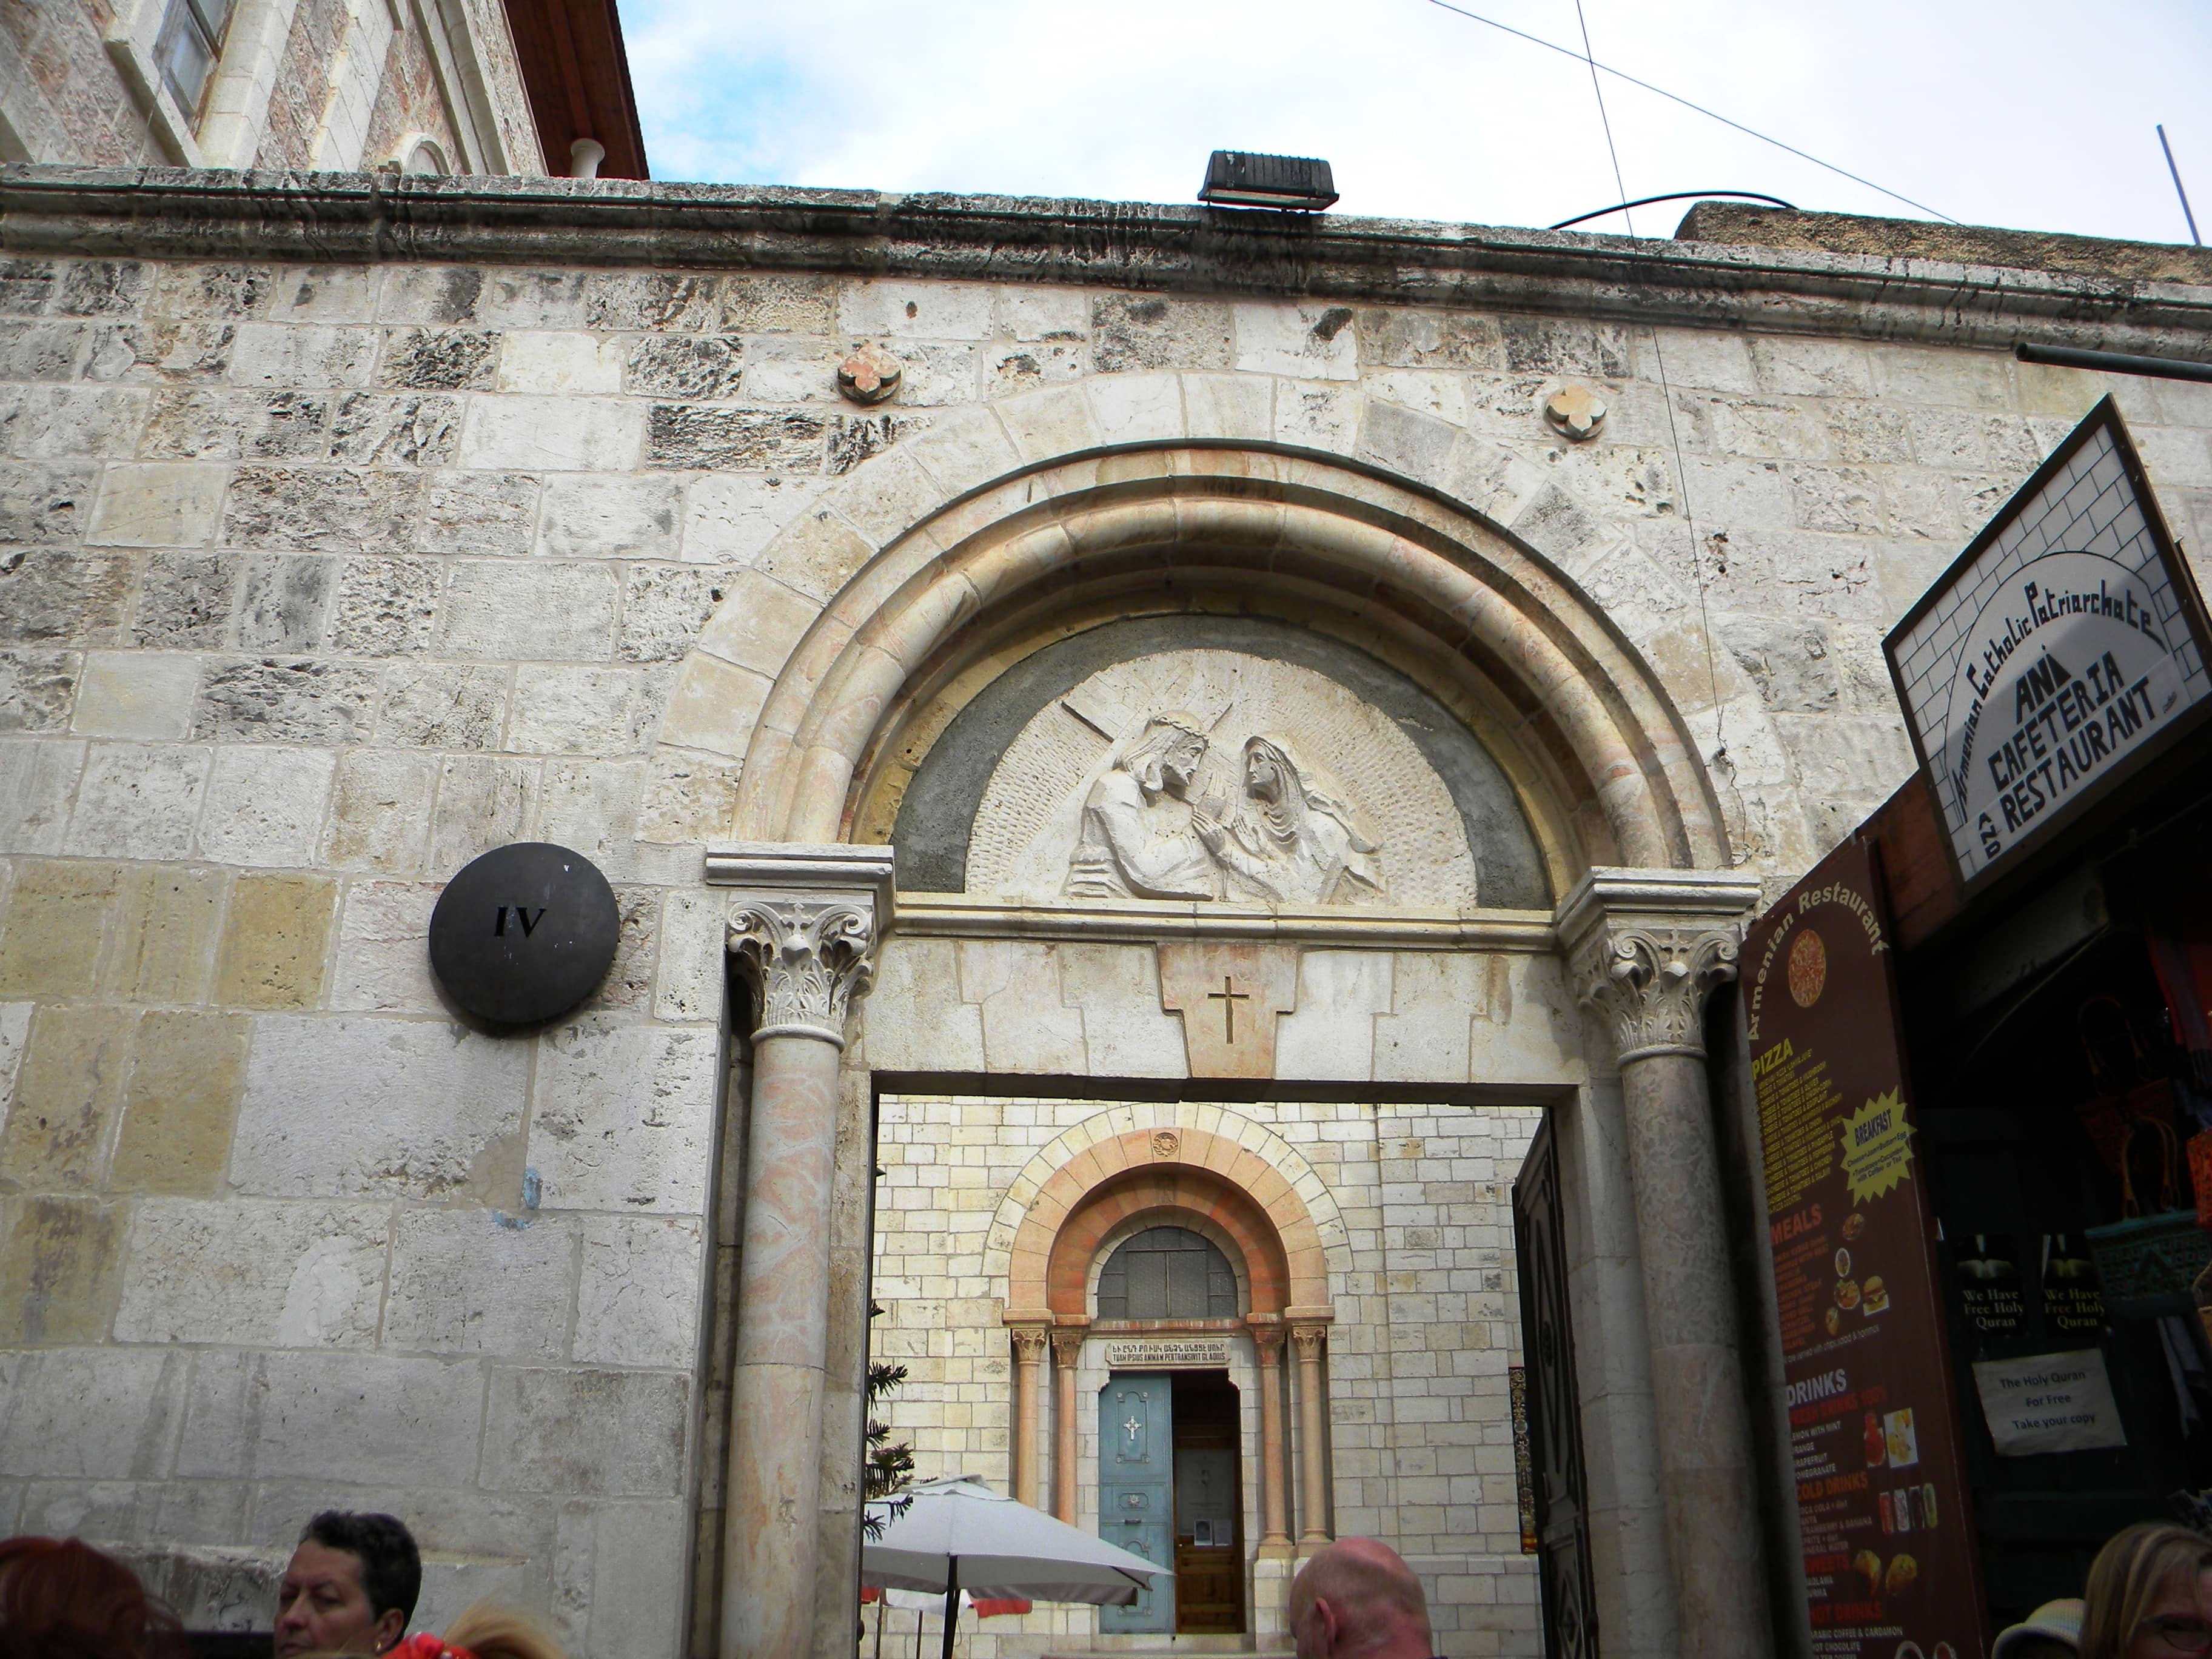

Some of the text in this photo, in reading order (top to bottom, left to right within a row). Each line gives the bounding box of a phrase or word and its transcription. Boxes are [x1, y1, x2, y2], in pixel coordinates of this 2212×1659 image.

[1951, 698, 1983, 824] Armenian
[2024, 578, 2169, 655] Patriarchate
[1988, 650, 2125, 792] CAFETERIA
[2000, 676, 2156, 834] RESTAURANT
[494, 906, 547, 939] IV
[1748, 880, 1891, 1041] Armenian Restaurant
[1751, 1037, 1795, 1081] PIZZA
[1854, 1108, 1892, 1147] BREAKFAST
[1769, 1202, 1823, 1247] MEALS
[1961, 1288, 2019, 1301] We Have
[2043, 1288, 2101, 1301] We Have
[1963, 1301, 2024, 1316] Free Holy
[2043, 1301, 2106, 1317] Free Holy
[1975, 1316, 2017, 1331] Quran
[2056, 1315, 2098, 1330] Quran
[1785, 1368, 1848, 1407] DRINKS
[1999, 1371, 2086, 1389] The Holy Quran
[2025, 1394, 2073, 1407] For Free
[2011, 1413, 2096, 1430] Take your copy
[1794, 1452, 1828, 1467] RAPEFRUIT
[1795, 1463, 1837, 1480] OMEGRANATE
